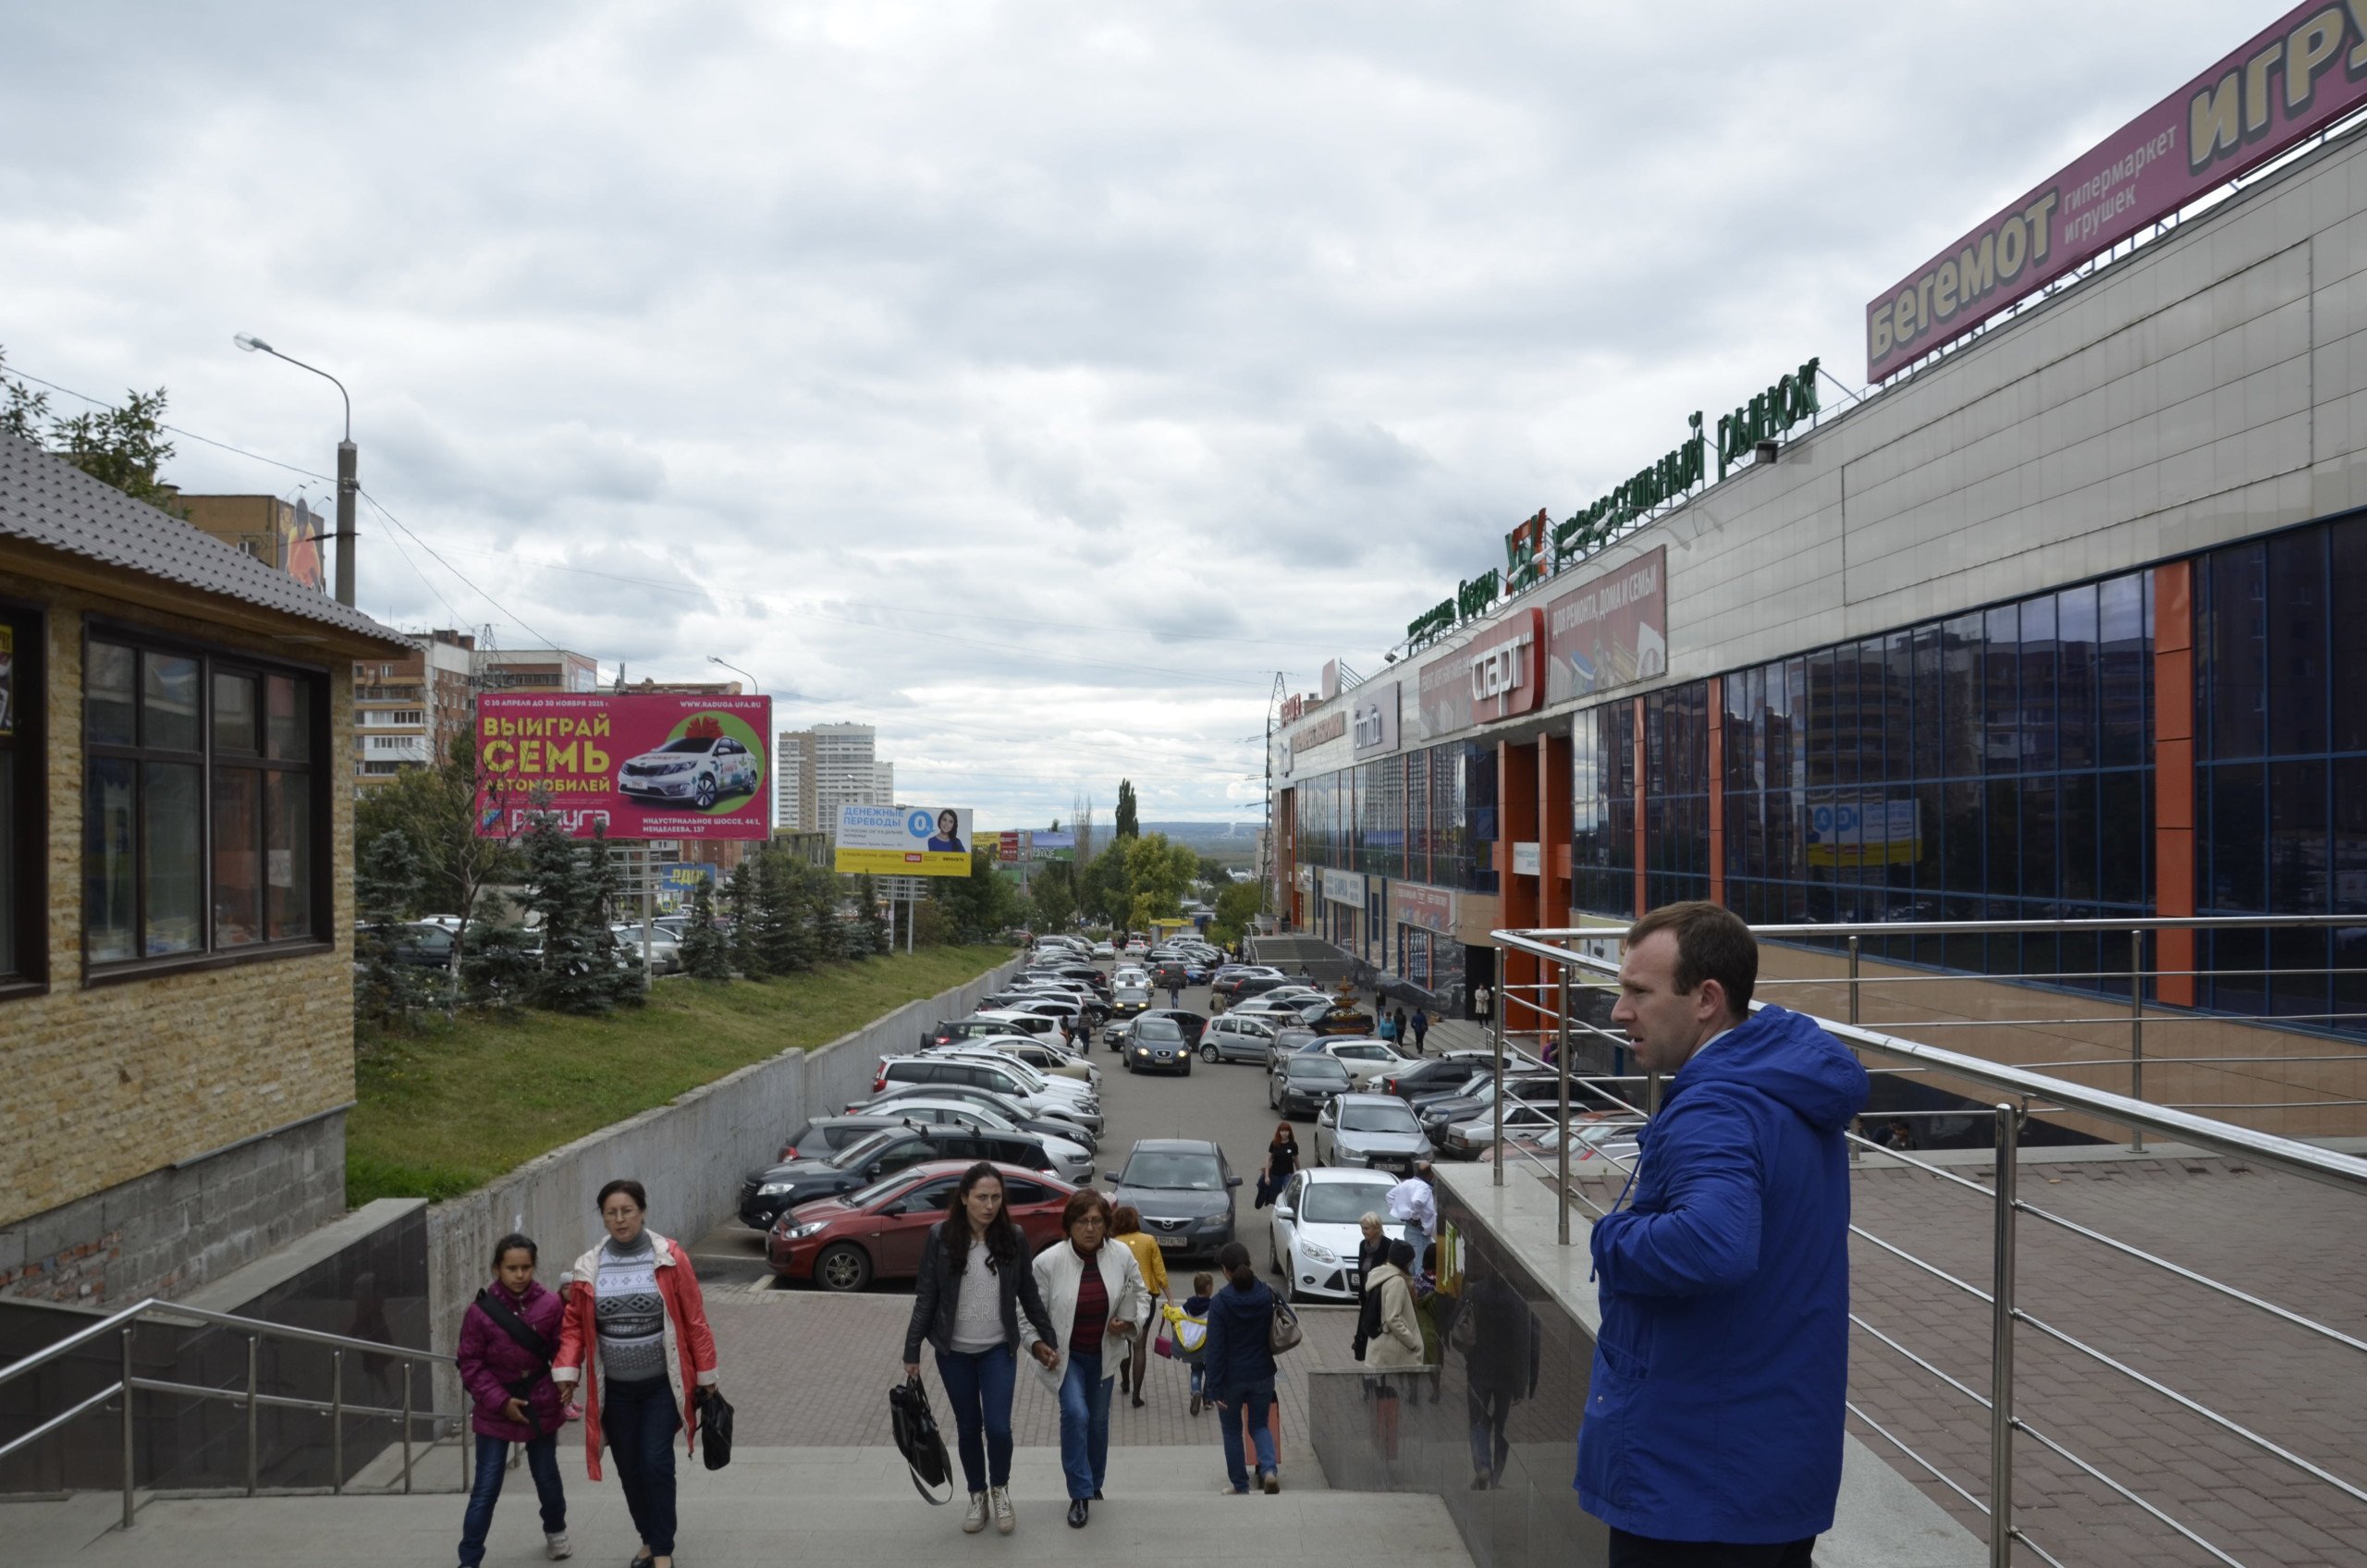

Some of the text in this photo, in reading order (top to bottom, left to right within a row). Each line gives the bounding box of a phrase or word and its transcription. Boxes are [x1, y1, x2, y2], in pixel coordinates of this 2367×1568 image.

[2064, 124, 2177, 215] гипермаркет
[2065, 187, 2137, 245] игрушек
[1599, 582, 1621, 620] ДОМА
[1629, 563, 1657, 603] СЕМЬИ
[588, 700, 605, 708] 2015
[484, 713, 610, 737] ВЫИГРАЙ
[483, 739, 610, 773] СЕМЬ
[843, 806, 904, 817] ДЕНЕЖНЫЕ
[843, 816, 901, 827] ПЕРЕВОДЫ
[963, 1280, 1000, 1300] FOR
